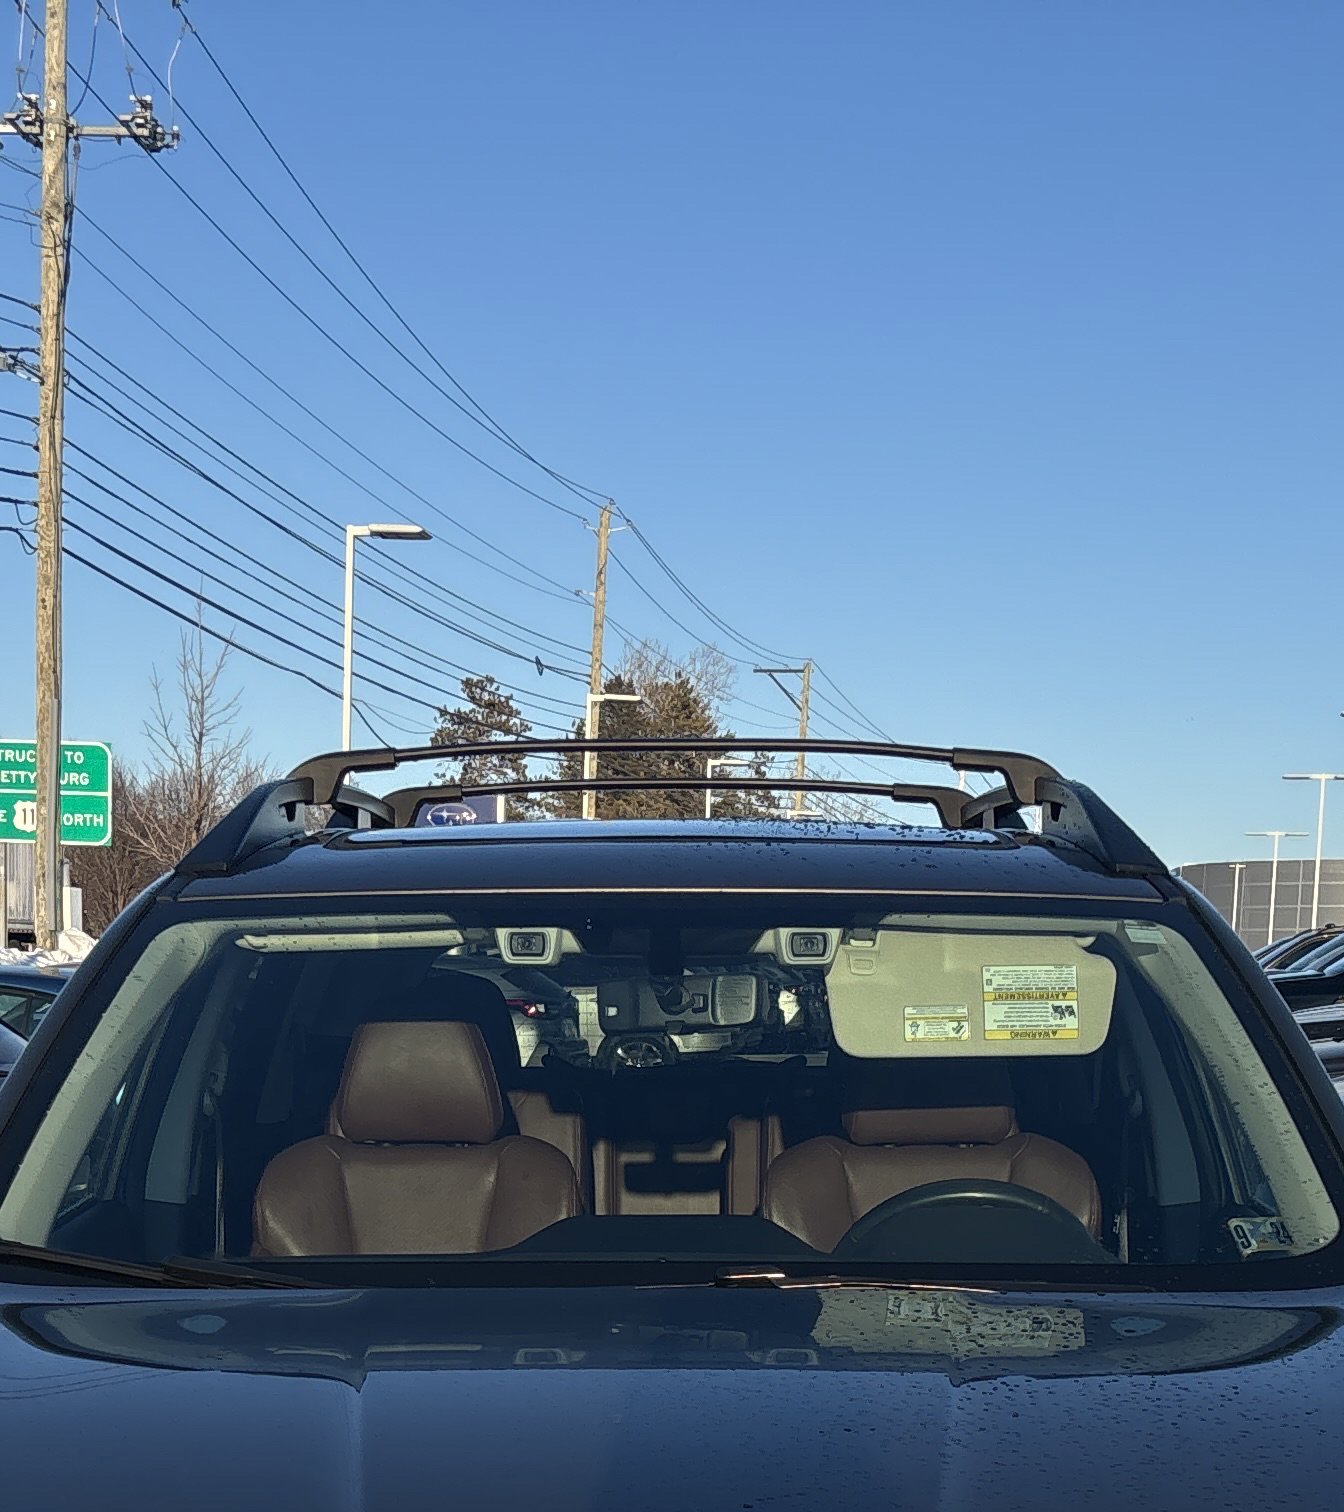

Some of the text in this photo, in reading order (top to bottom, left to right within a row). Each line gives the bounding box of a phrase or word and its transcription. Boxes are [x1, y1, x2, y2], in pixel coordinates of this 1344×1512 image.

[64, 751, 84, 764] TO
[21, 807, 35, 825] 11
[62, 813, 104, 827] ORTH
[1233, 1224, 1252, 1249] 9
